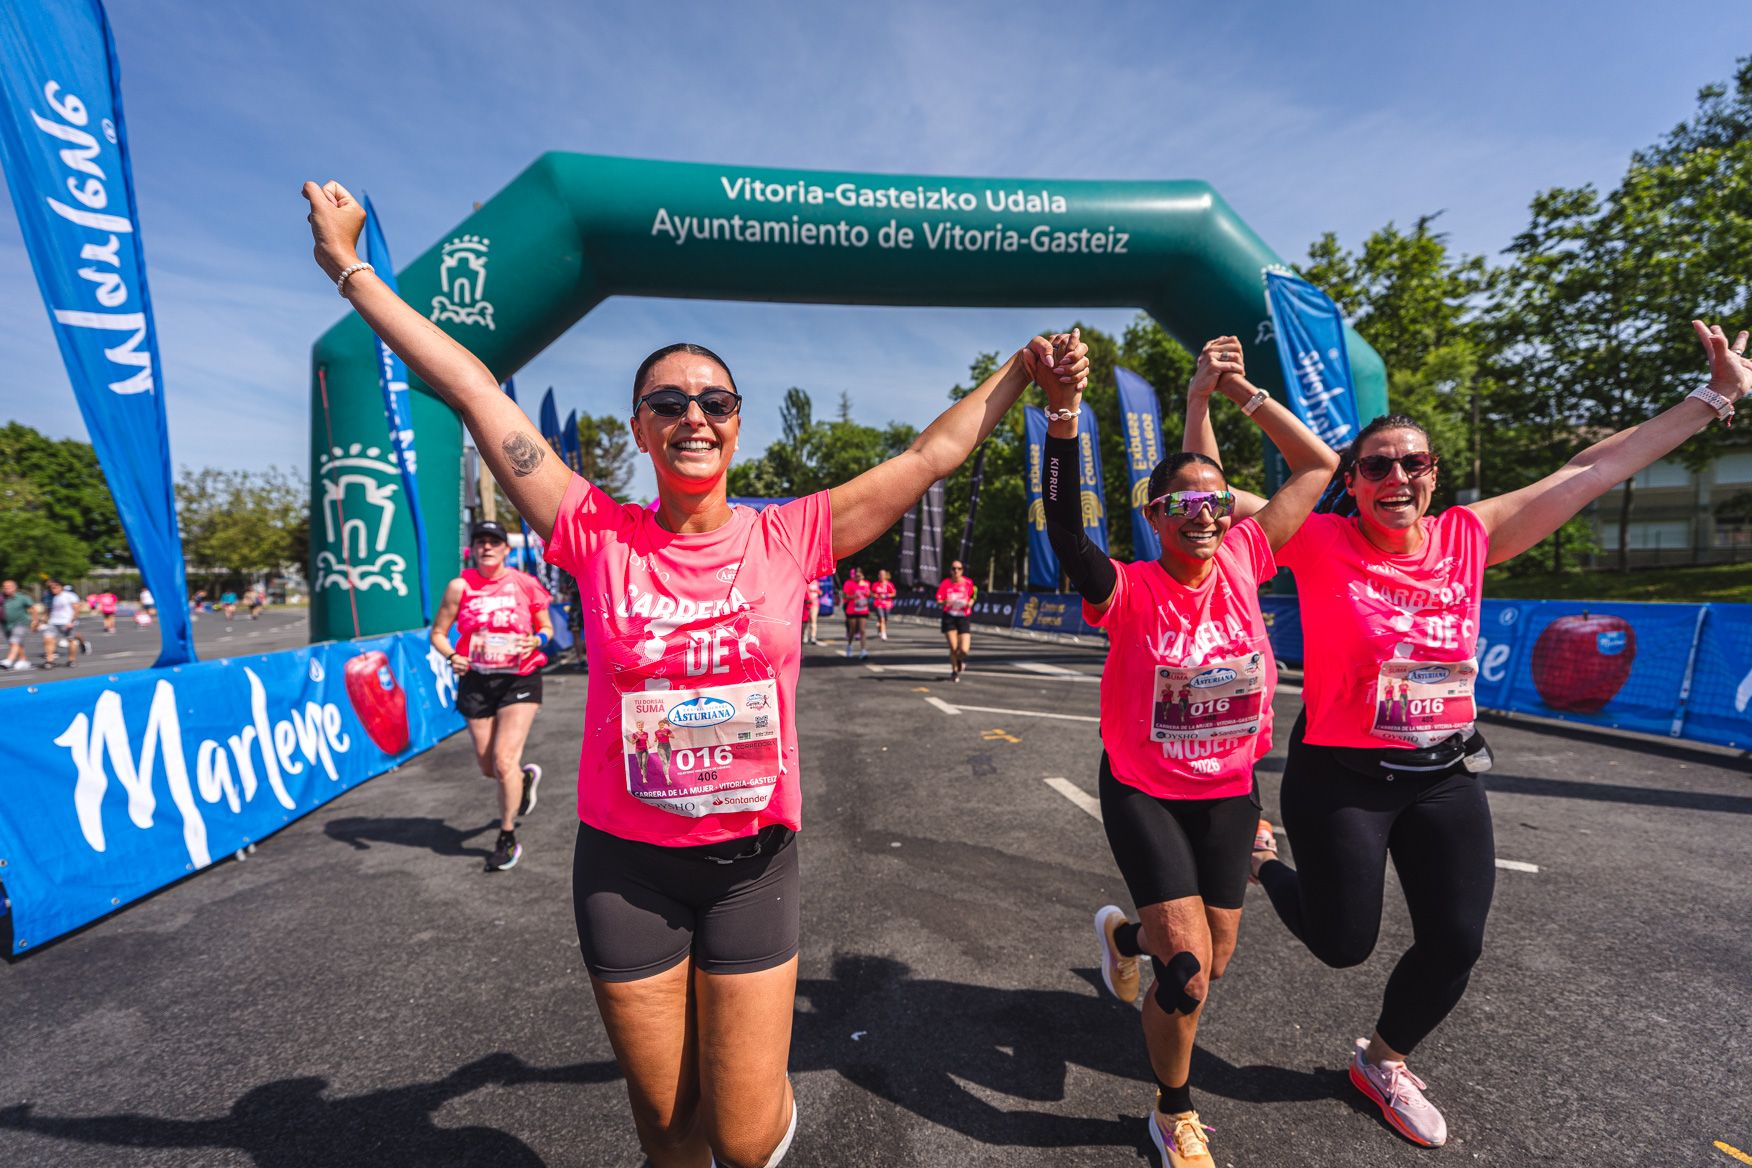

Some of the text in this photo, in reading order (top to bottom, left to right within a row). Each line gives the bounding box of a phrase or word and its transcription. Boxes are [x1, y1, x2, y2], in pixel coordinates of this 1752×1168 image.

[721, 176, 1067, 213] Vitoria-Gasteizko Udala
[650, 207, 1130, 254] Ayuntamiento de Vitoria-Gasteiz
[1049, 457, 1059, 502] KIPRUN
[630, 553, 670, 584] OYSO
[974, 602, 1013, 615] OLVO
[1425, 612, 1460, 650] DE
[686, 630, 730, 677] DE
[1193, 673, 1234, 686] ASTURIANA
[636, 704, 666, 713] SUMA
[673, 709, 731, 722] ASTURIANA
[1190, 698, 1231, 716] 016
[1409, 698, 1444, 715] 016
[1164, 732, 1198, 740] OYSHO
[676, 745, 733, 769] 016
[1190, 758, 1221, 774] 2026
[53, 666, 351, 869] Marlene
[697, 771, 718, 782] 406
[635, 775, 778, 798] CARRERA DE LA MUJER VITORIA-GASTEIZ
[725, 794, 768, 805] Santander
